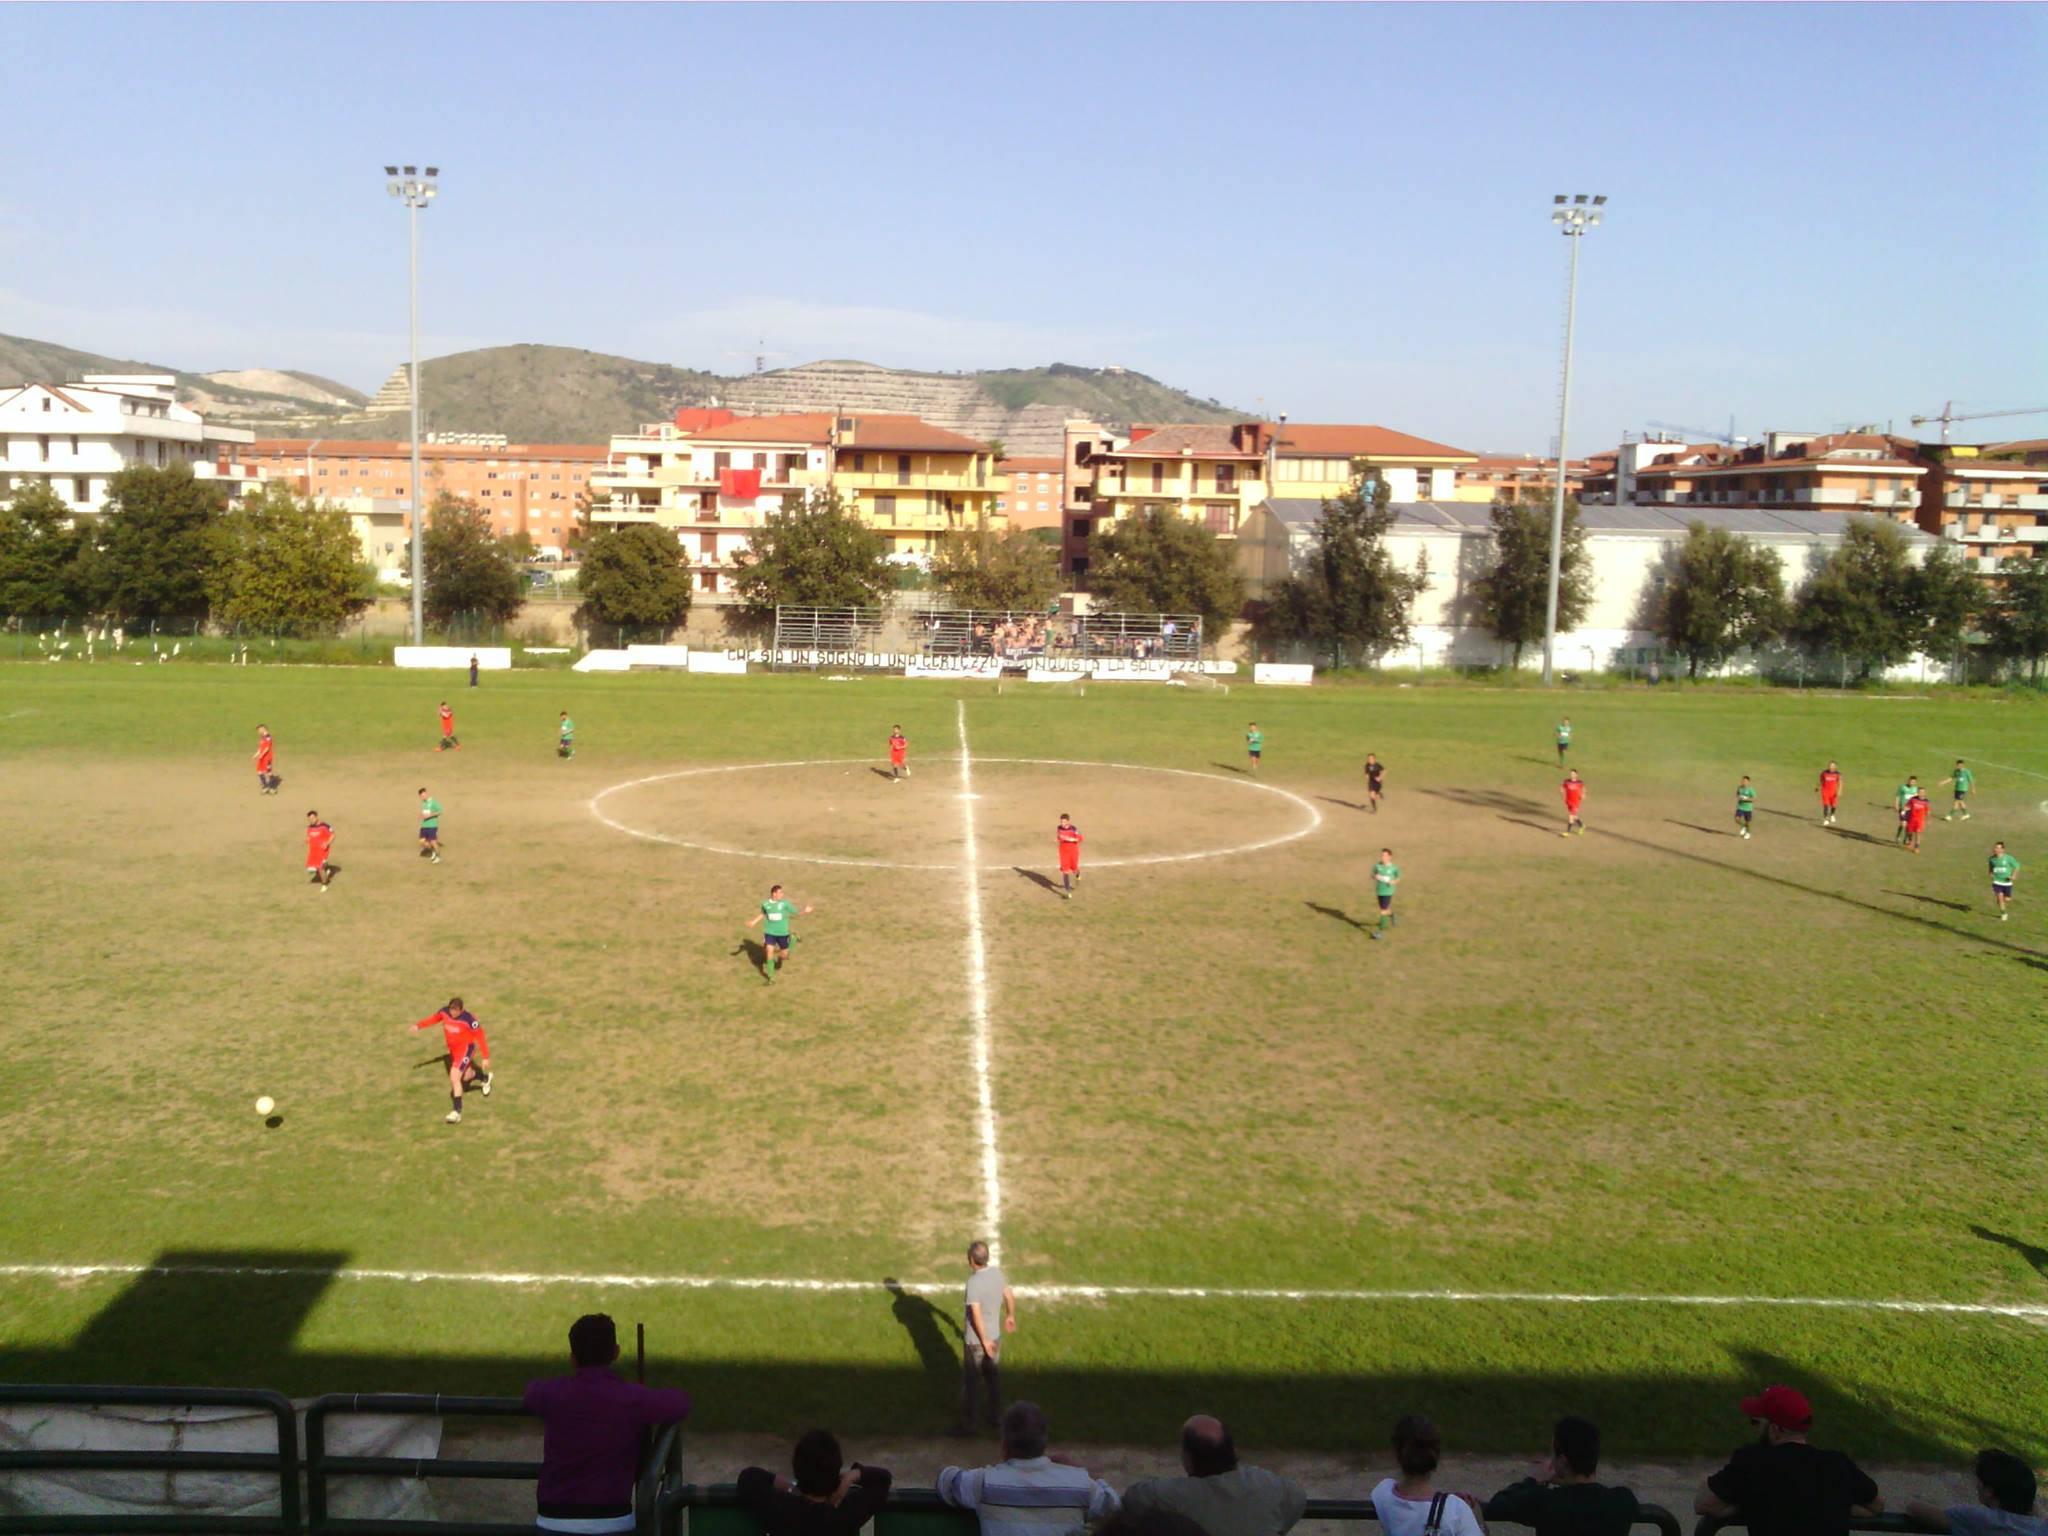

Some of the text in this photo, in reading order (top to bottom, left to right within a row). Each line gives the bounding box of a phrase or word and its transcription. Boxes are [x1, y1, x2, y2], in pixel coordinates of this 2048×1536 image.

[728, 649, 755, 661] CHE
[761, 649, 783, 663] SIA
[791, 650, 809, 664] UN
[818, 651, 866, 666] SOGNO
[888, 653, 916, 667] UNA
